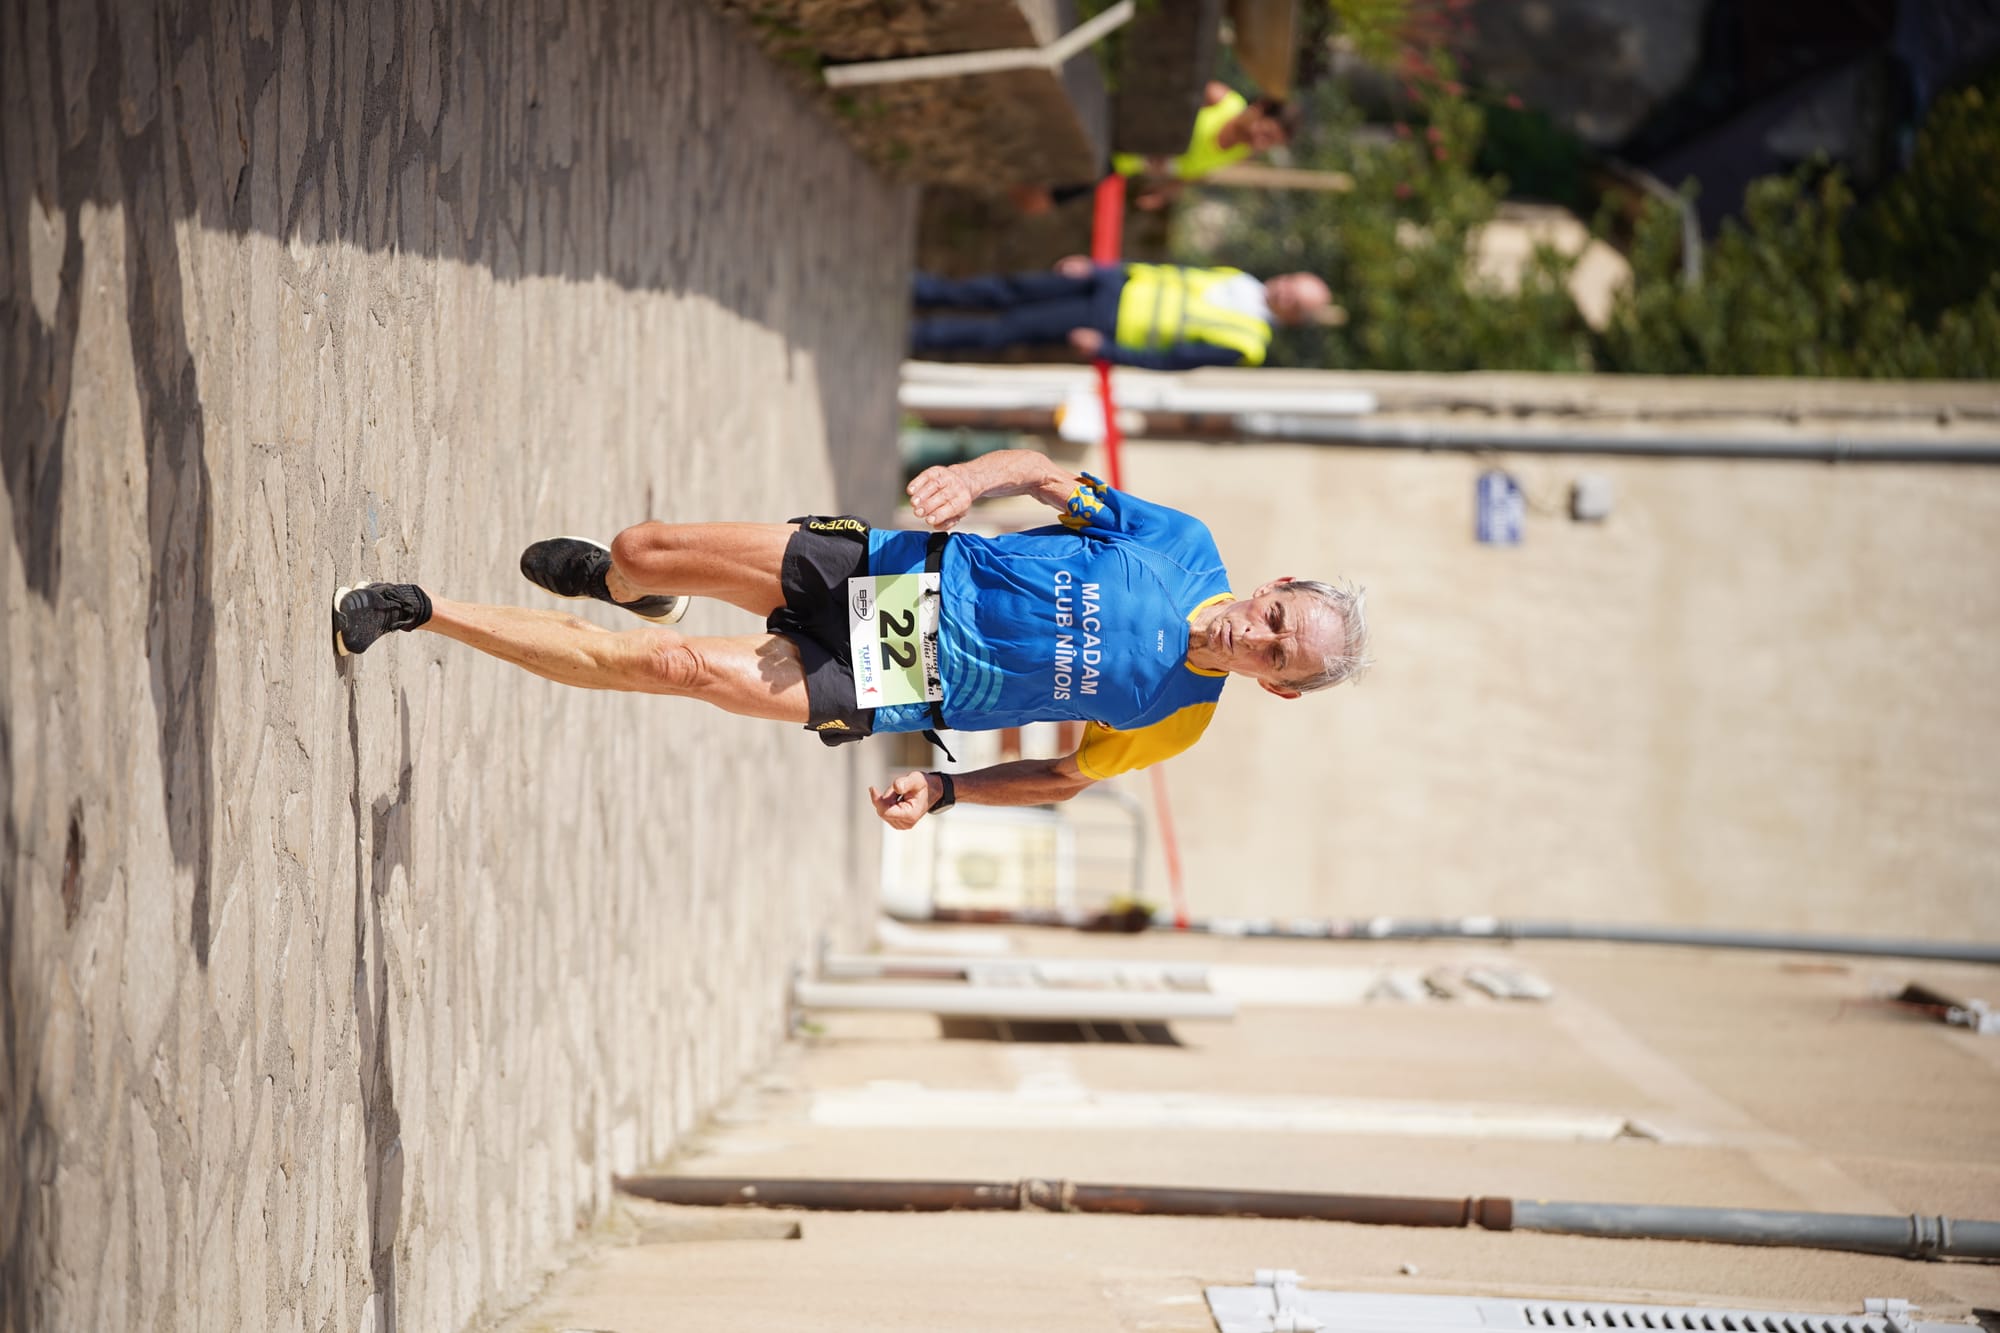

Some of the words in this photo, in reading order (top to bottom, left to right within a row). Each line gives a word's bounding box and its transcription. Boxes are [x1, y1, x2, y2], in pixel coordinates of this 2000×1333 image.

[859, 589, 868, 617] BFP
[1054, 570, 1073, 628] CLUB
[862, 644, 873, 683] TUFF'S
[879, 609, 917, 671] 22
[1053, 634, 1077, 700] NÎMOIS
[1080, 583, 1101, 695] MACADAM
